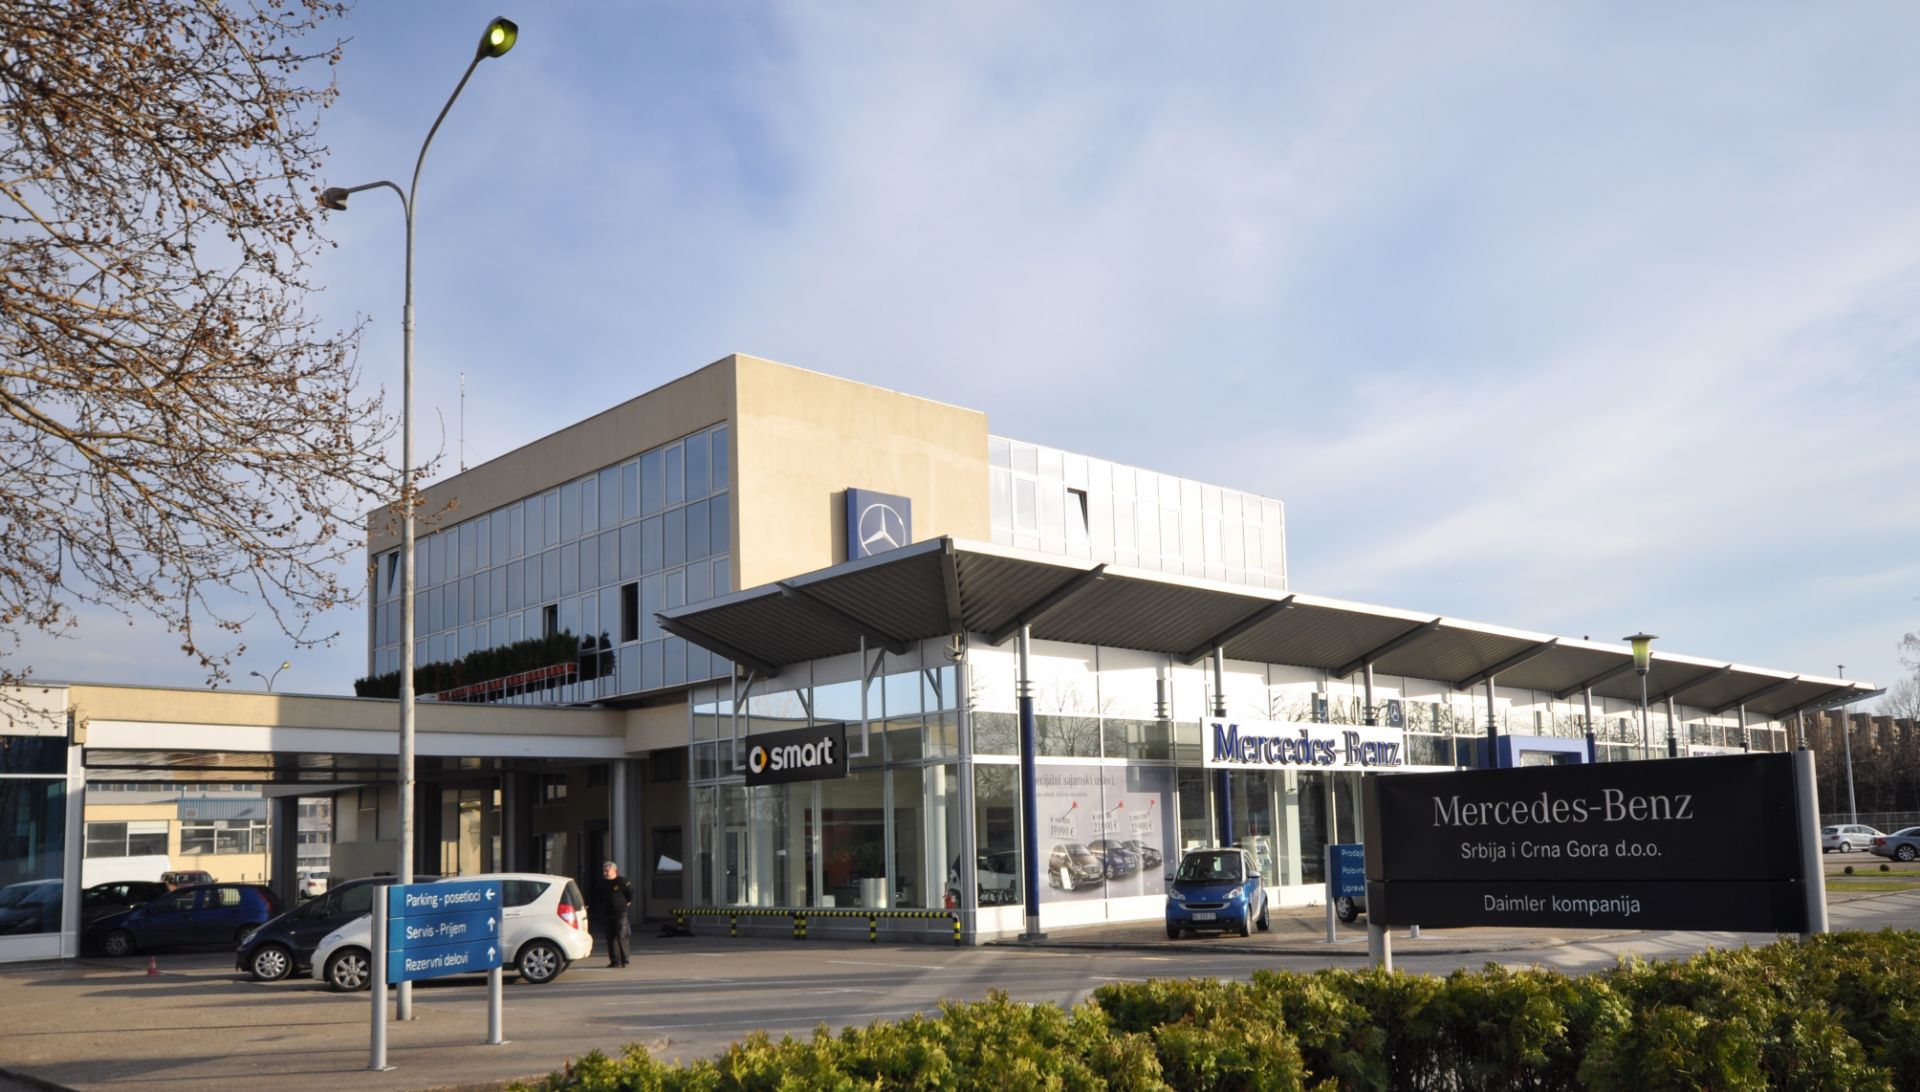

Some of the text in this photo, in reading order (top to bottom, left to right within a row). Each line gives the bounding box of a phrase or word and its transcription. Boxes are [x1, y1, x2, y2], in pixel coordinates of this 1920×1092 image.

[770, 736, 833, 770] smart
[1211, 723, 1401, 767] Mercedes-Benz
[1035, 774, 1061, 788] ecijalni
[1063, 774, 1092, 788] sajamski
[1432, 788, 1694, 827] Mercedes-Benz
[1461, 839, 1662, 862] Srbija i Crna Gora d.o.o.
[406, 892, 438, 908] Parking
[444, 889, 481, 907] posetioci
[1342, 884, 1365, 894] Uprava
[1484, 894, 1641, 916] Daimler kompanija
[406, 924, 434, 940] Servis
[440, 922, 467, 937] Prijem
[405, 951, 469, 972] Rezervni delovi
